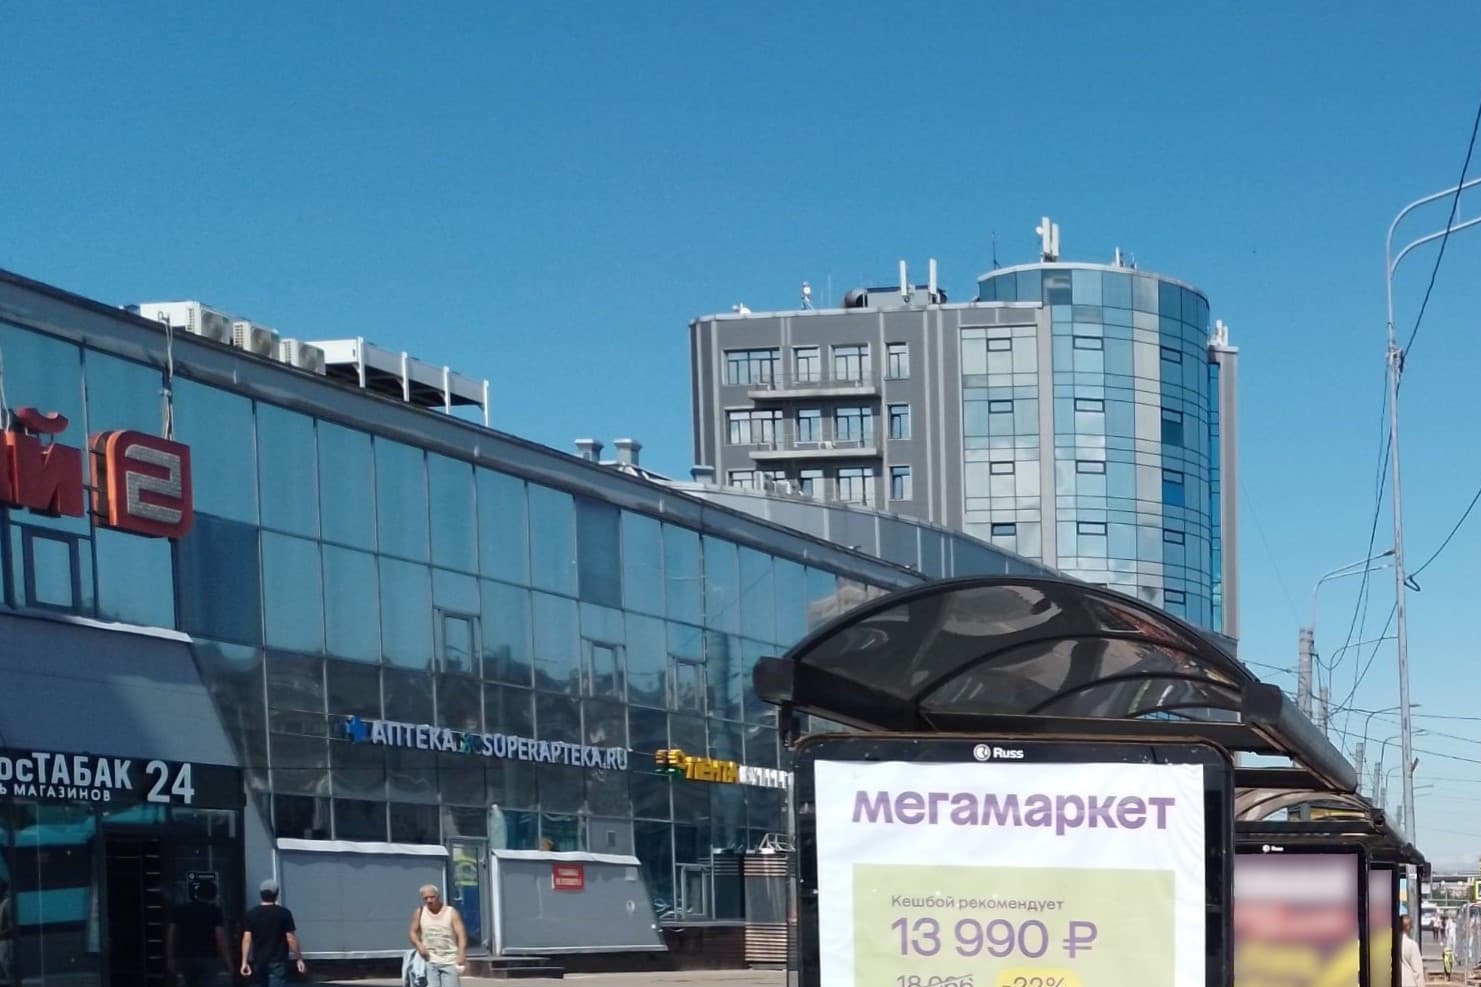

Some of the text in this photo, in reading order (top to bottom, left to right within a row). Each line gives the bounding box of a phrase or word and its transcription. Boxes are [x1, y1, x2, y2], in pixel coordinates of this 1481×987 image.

[371, 720, 456, 752] АПТЕКА
[481, 733, 629, 770] SUPERAPTEKA.RU
[992, 746, 1025, 760] Russ
[13, 783, 111, 802] МАГАЗИНОВ
[145, 760, 196, 804] 24
[851, 790, 1176, 836] мегамаркет
[891, 894, 1064, 912] Кешбой рекомендует
[891, 917, 941, 957] 13
[955, 918, 1049, 959] 990
